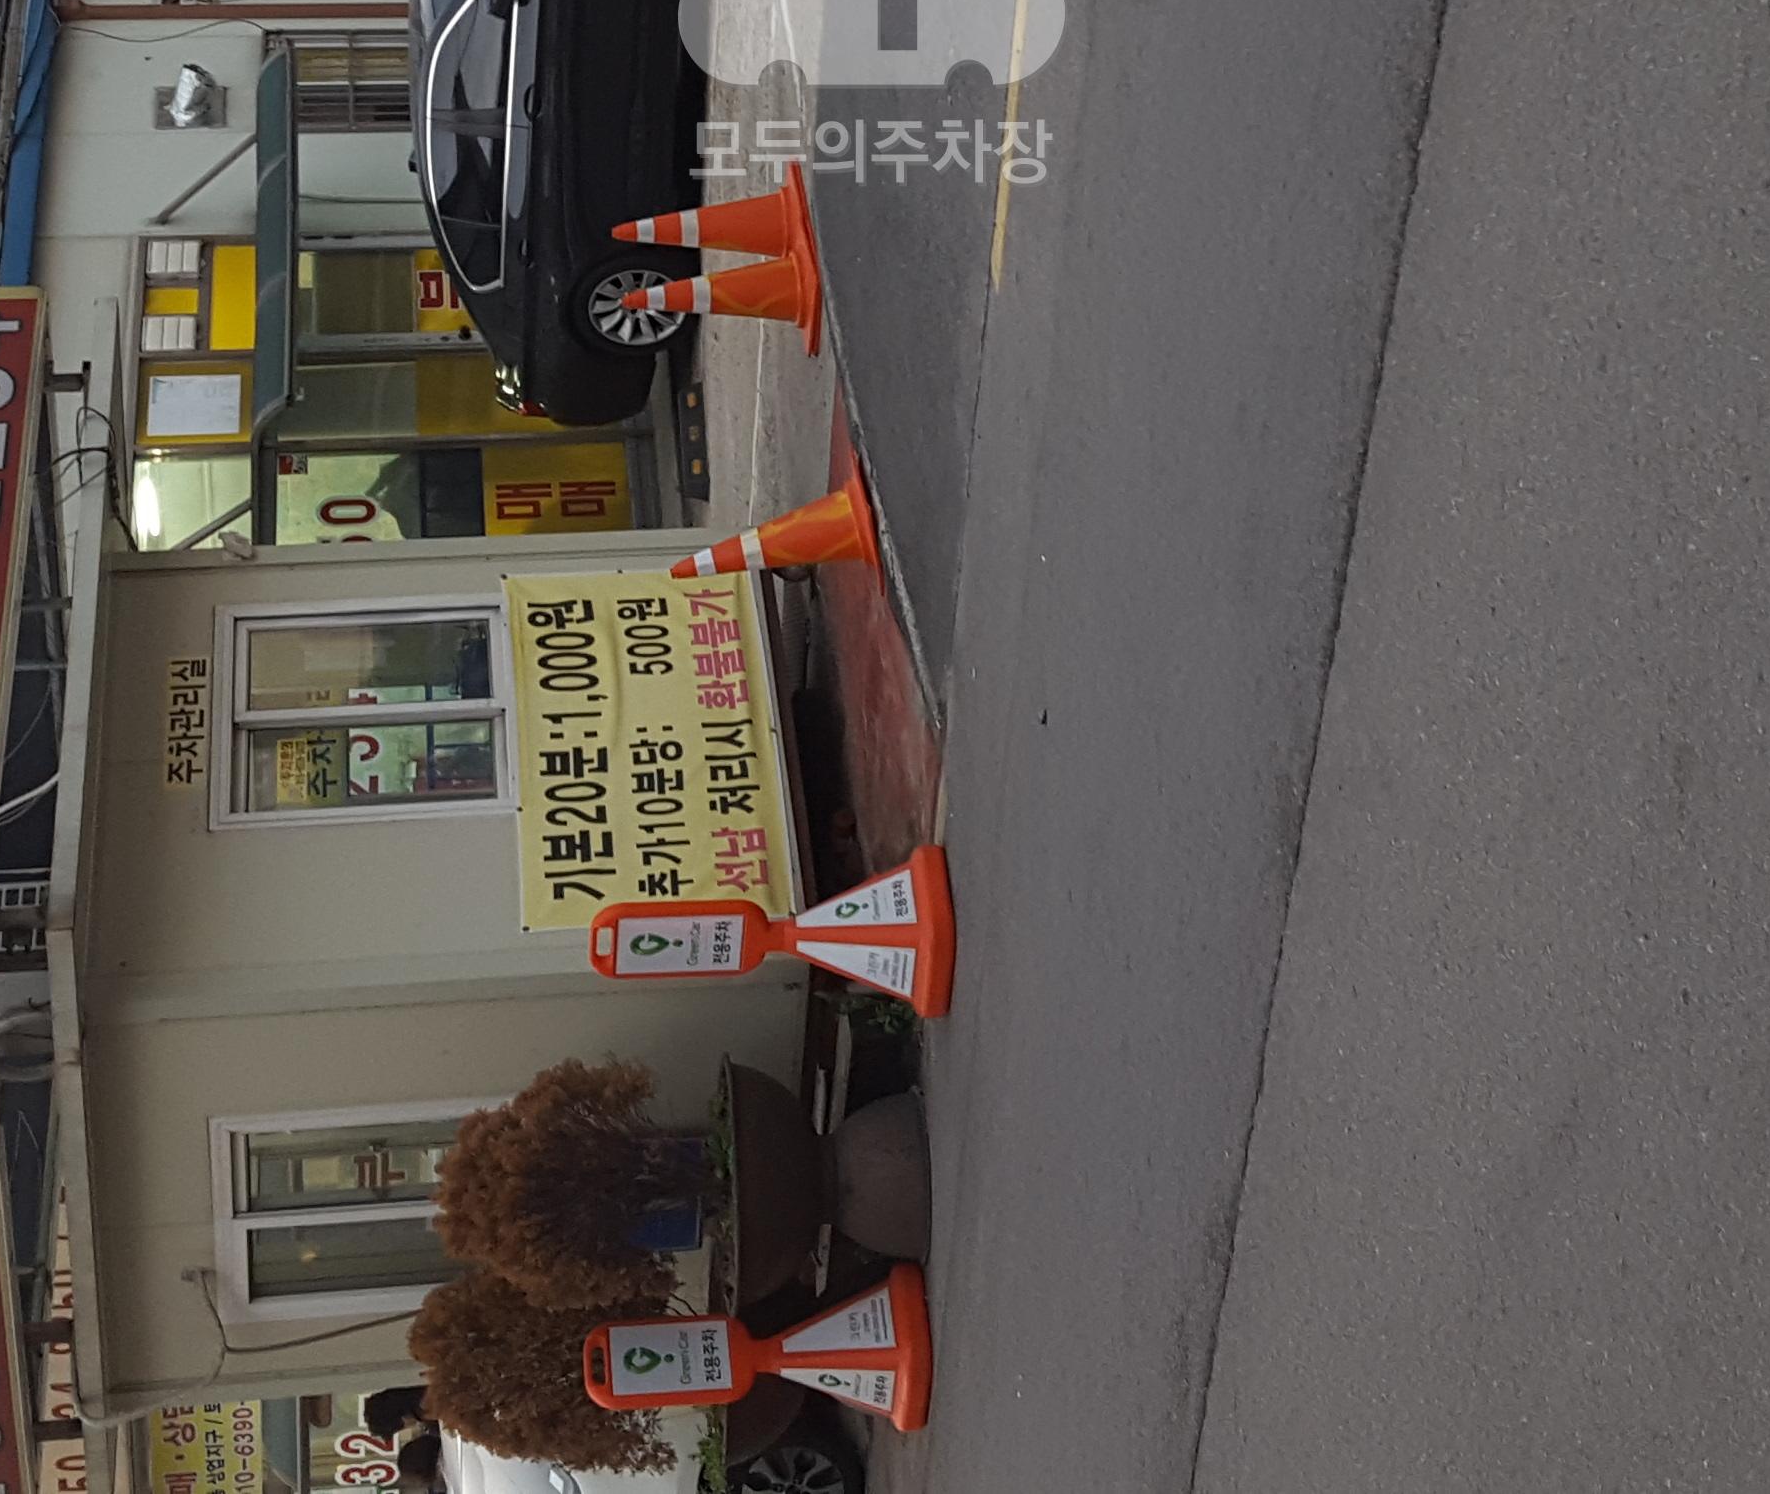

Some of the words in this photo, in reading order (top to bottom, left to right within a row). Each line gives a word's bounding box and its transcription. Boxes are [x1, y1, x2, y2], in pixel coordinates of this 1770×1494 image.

[495, 481, 617, 520] 매매
[617, 597, 674, 676] 500원
[684, 588, 750, 710] 환불불가
[166, 658, 207, 785] 주차관리실
[702, 718, 761, 815] 처리시
[711, 826, 770, 892] 선납
[712, 920, 732, 964] 전용주차
[701, 1329, 722, 1382] 전용주차
[205, 1429, 226, 1485] 상업지구
